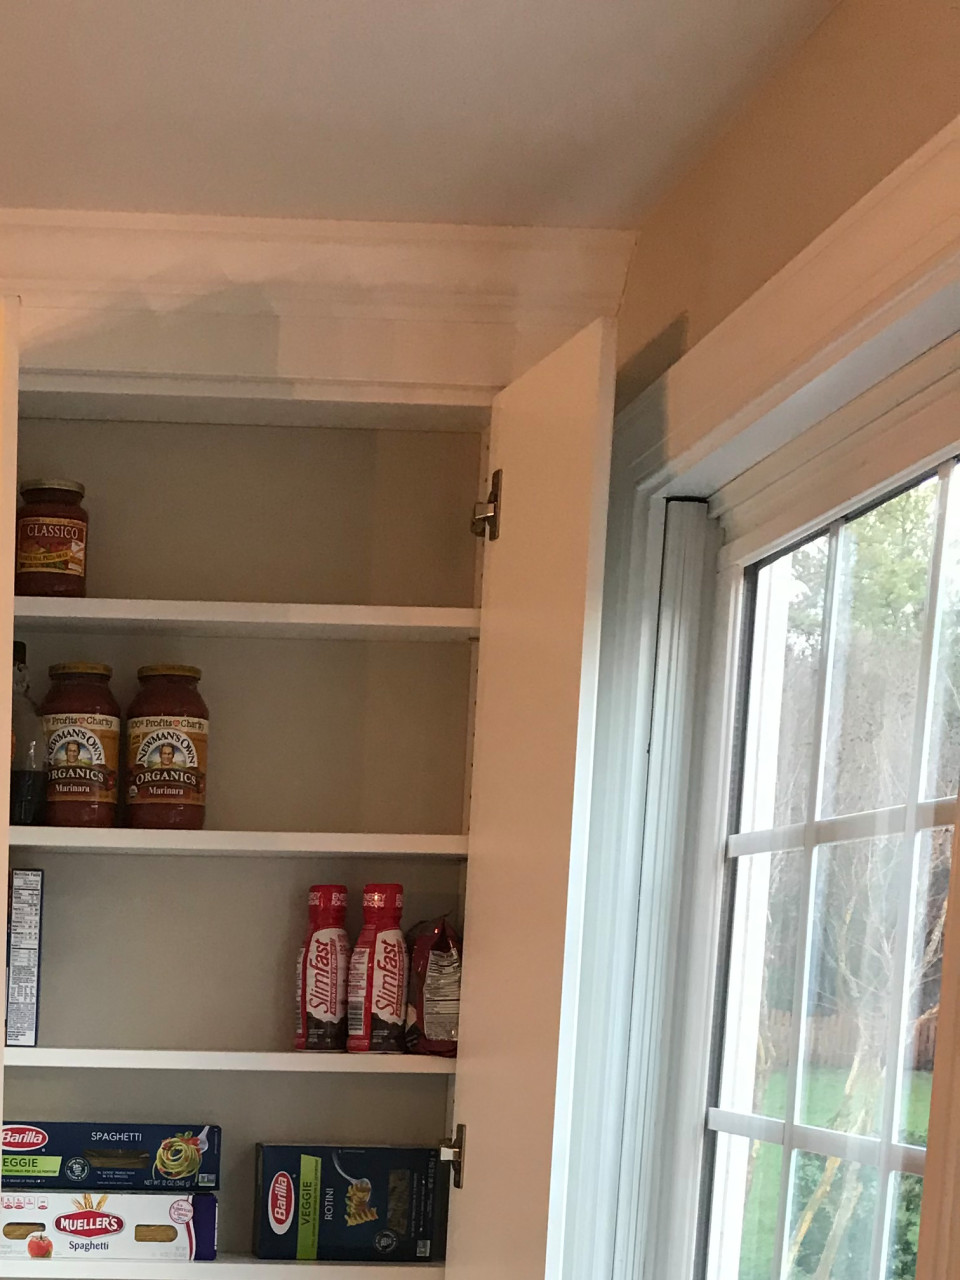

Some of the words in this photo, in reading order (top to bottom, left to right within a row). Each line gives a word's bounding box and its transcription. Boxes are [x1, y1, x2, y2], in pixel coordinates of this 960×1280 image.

[27, 525, 79, 539] CLASSICO
[51, 717, 78, 727] Profits
[86, 717, 113, 728] Charity
[145, 719, 174, 729] Profits
[181, 719, 206, 731] Charity
[136, 770, 198, 786] ORGANICS
[55, 784, 91, 797] Marinara
[149, 787, 184, 799] Marinara
[2, 1131, 43, 1144] Barilla
[91, 1131, 142, 1142] SPAGHETTI
[2, 1157, 39, 1168] EGGIE
[274, 1175, 287, 1221] Barilla
[300, 1180, 313, 1226] VEGGIE
[324, 1187, 335, 1220] ROTINI
[60, 1216, 120, 1233] MUELLER'S
[68, 1240, 109, 1254] Spaghetti
